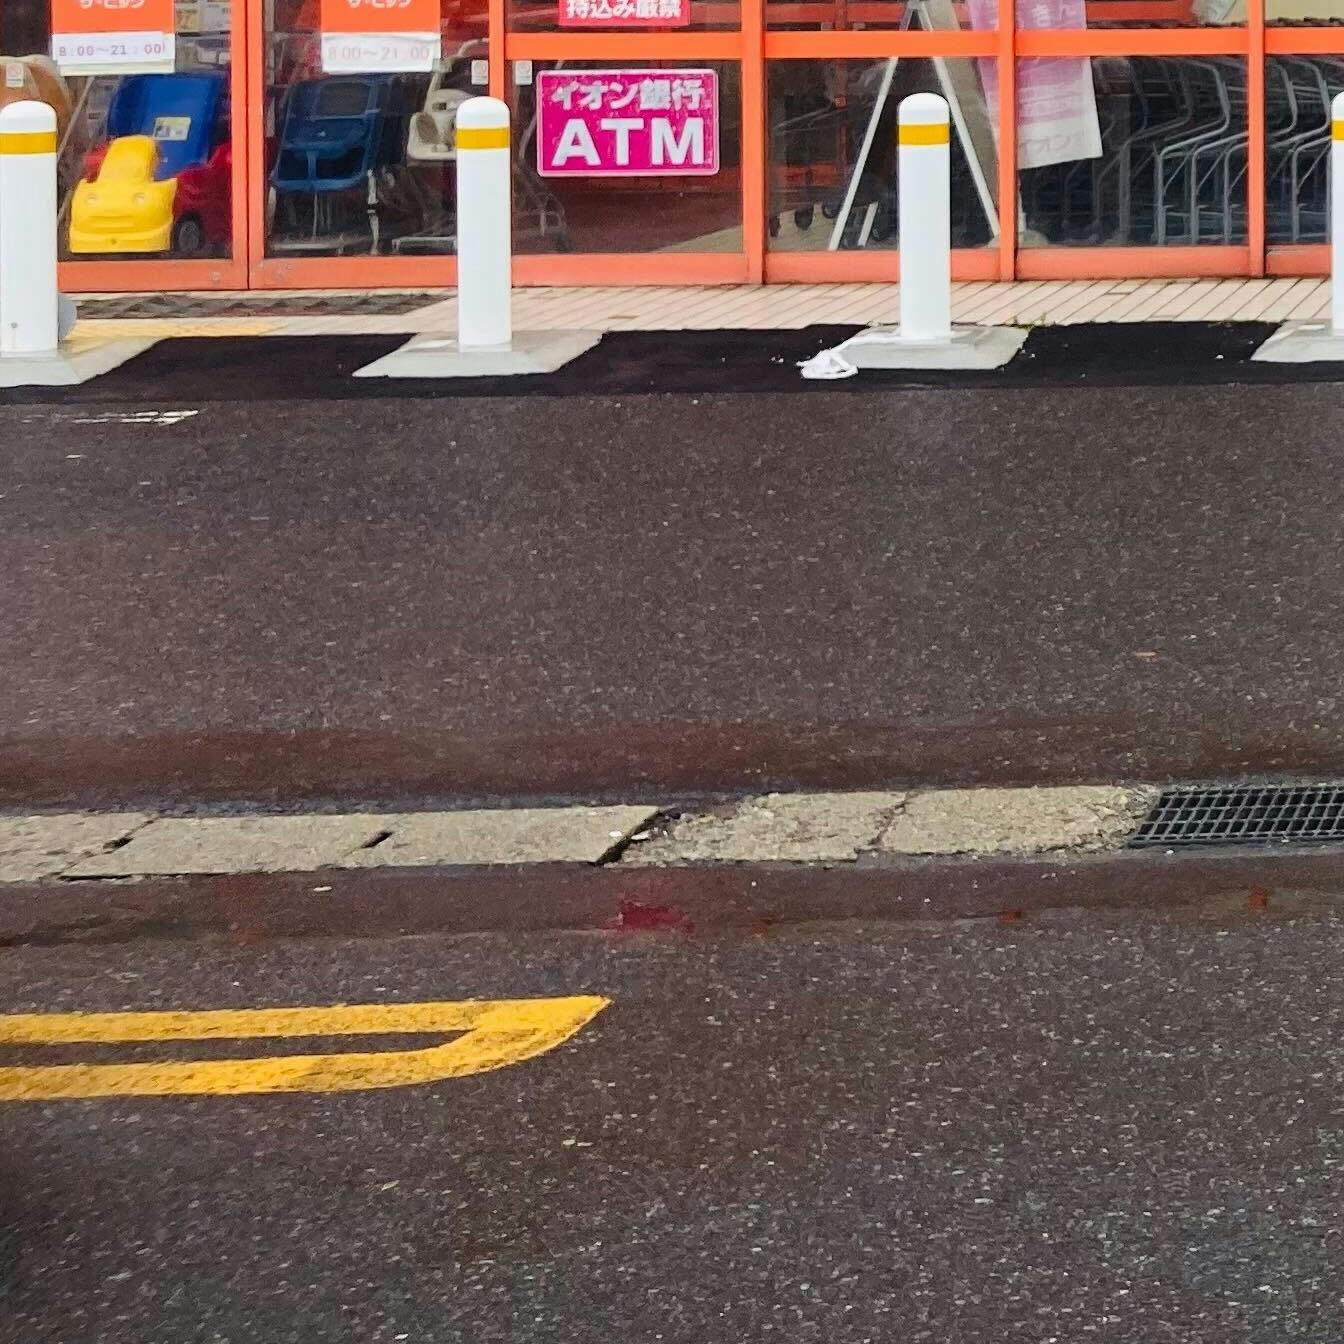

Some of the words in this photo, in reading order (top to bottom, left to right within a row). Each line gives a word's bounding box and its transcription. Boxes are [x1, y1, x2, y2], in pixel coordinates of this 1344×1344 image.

[552, 78, 706, 112] イオン銀行
[552, 118, 706, 167] ATM
